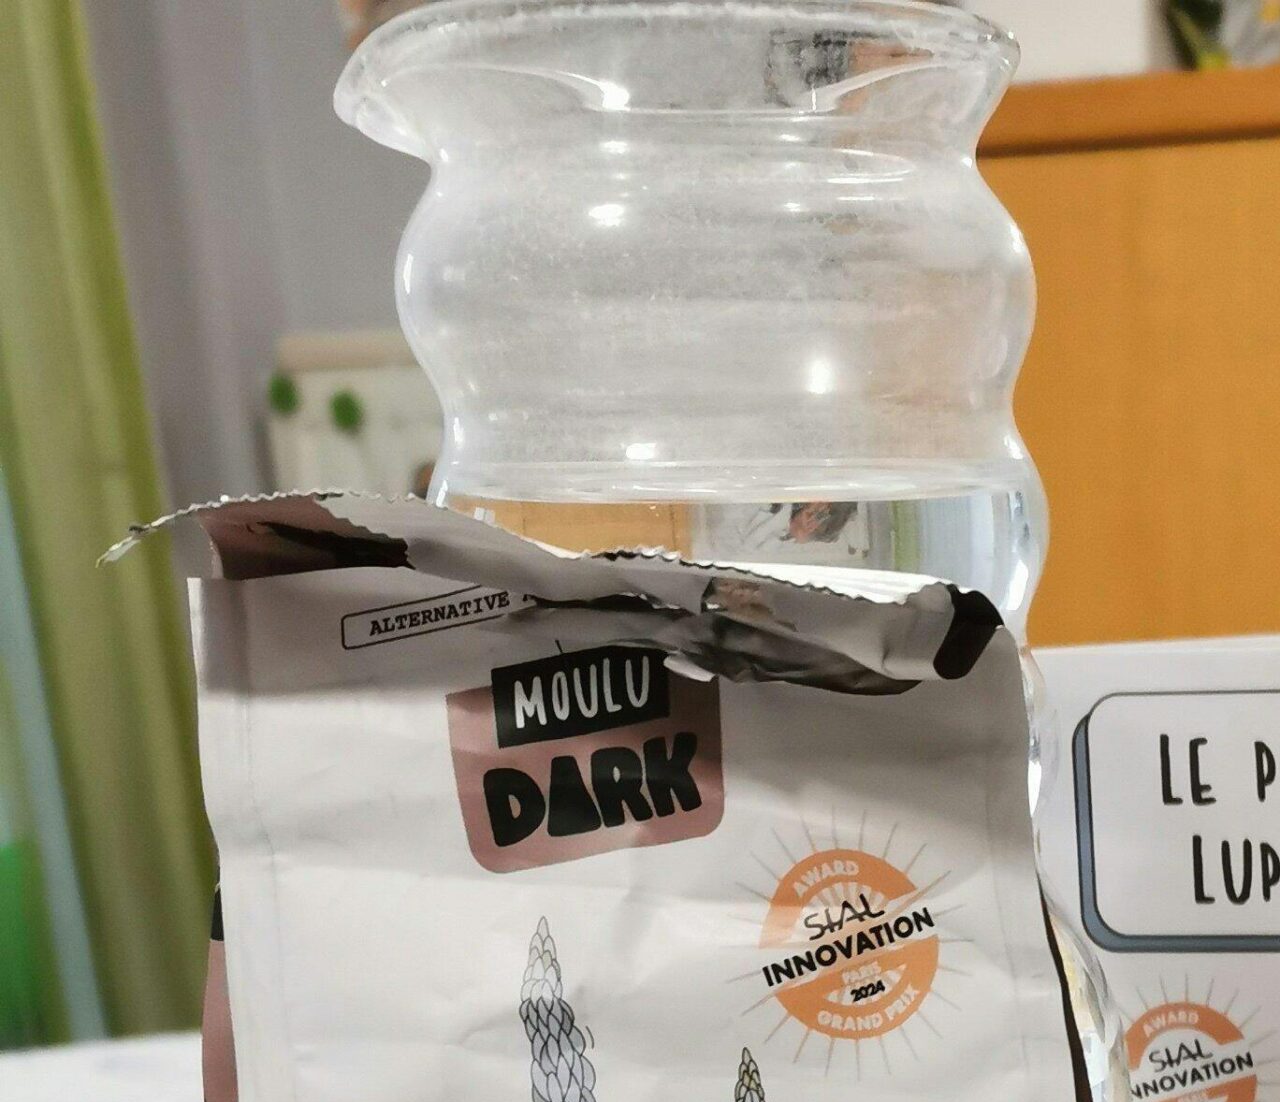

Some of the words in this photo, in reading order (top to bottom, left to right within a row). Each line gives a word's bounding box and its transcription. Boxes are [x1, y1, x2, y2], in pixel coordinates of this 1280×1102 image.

[369, 591, 511, 637] ALTERNATIVE
[514, 655, 650, 729] MOULU
[483, 731, 703, 848] DARK
[1159, 733, 1217, 806] LE
[794, 859, 860, 897] AWARD
[804, 893, 885, 941] SIAL
[762, 907, 935, 987] INNOVATION
[850, 980, 886, 1003] 2024
[817, 1010, 884, 1031] GRAND
[1143, 1010, 1200, 1038] AWARD
[1131, 1051, 1254, 1100] NNOVATION
[1148, 1038, 1214, 1073] SIAL
